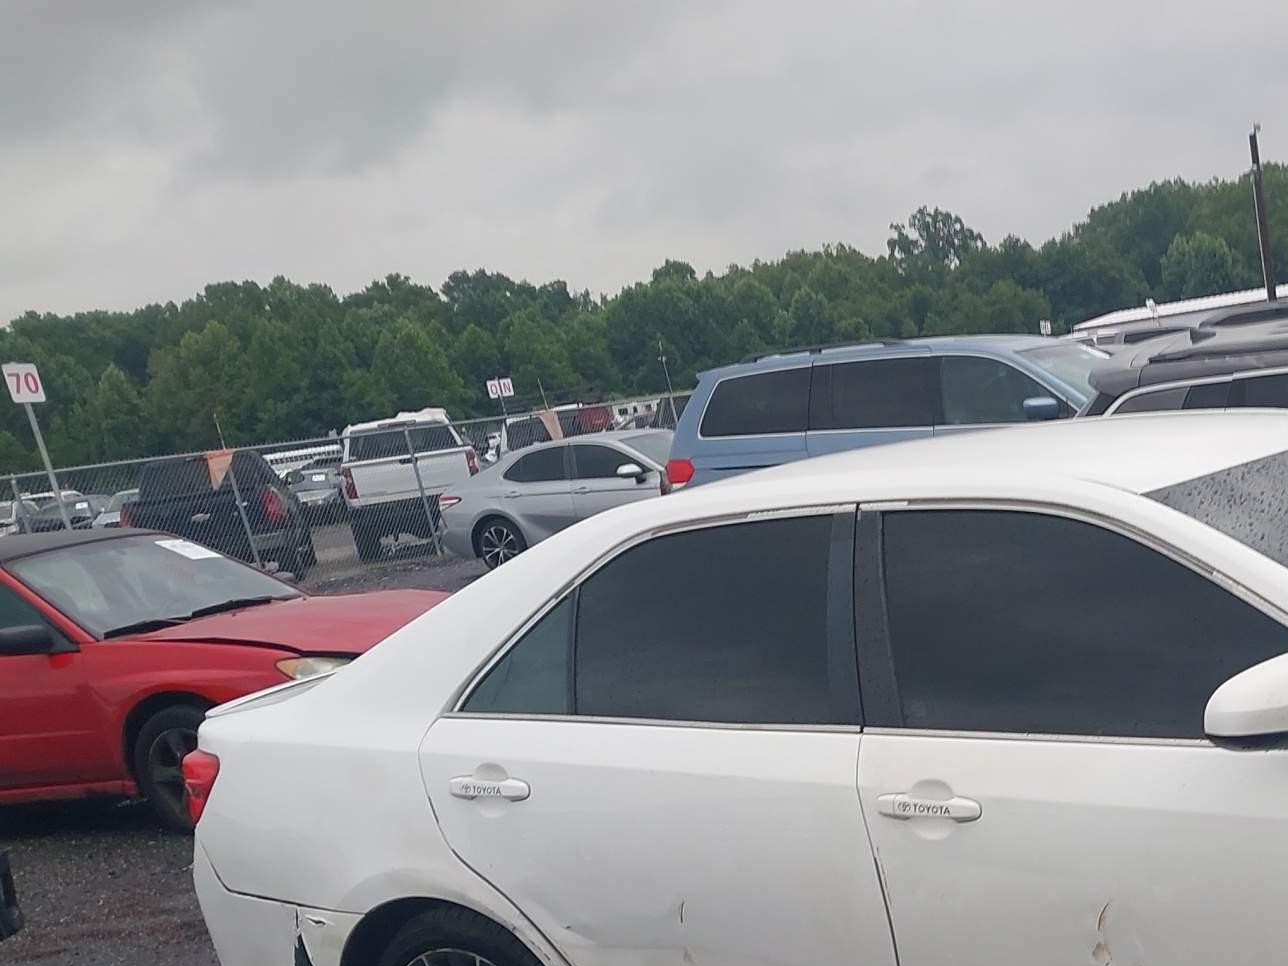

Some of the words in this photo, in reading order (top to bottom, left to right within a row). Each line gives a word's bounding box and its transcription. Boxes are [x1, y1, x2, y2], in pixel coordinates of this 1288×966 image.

[7, 372, 39, 394] 70
[472, 784, 502, 796] TOYOTA
[913, 802, 951, 815] TOYOTA
